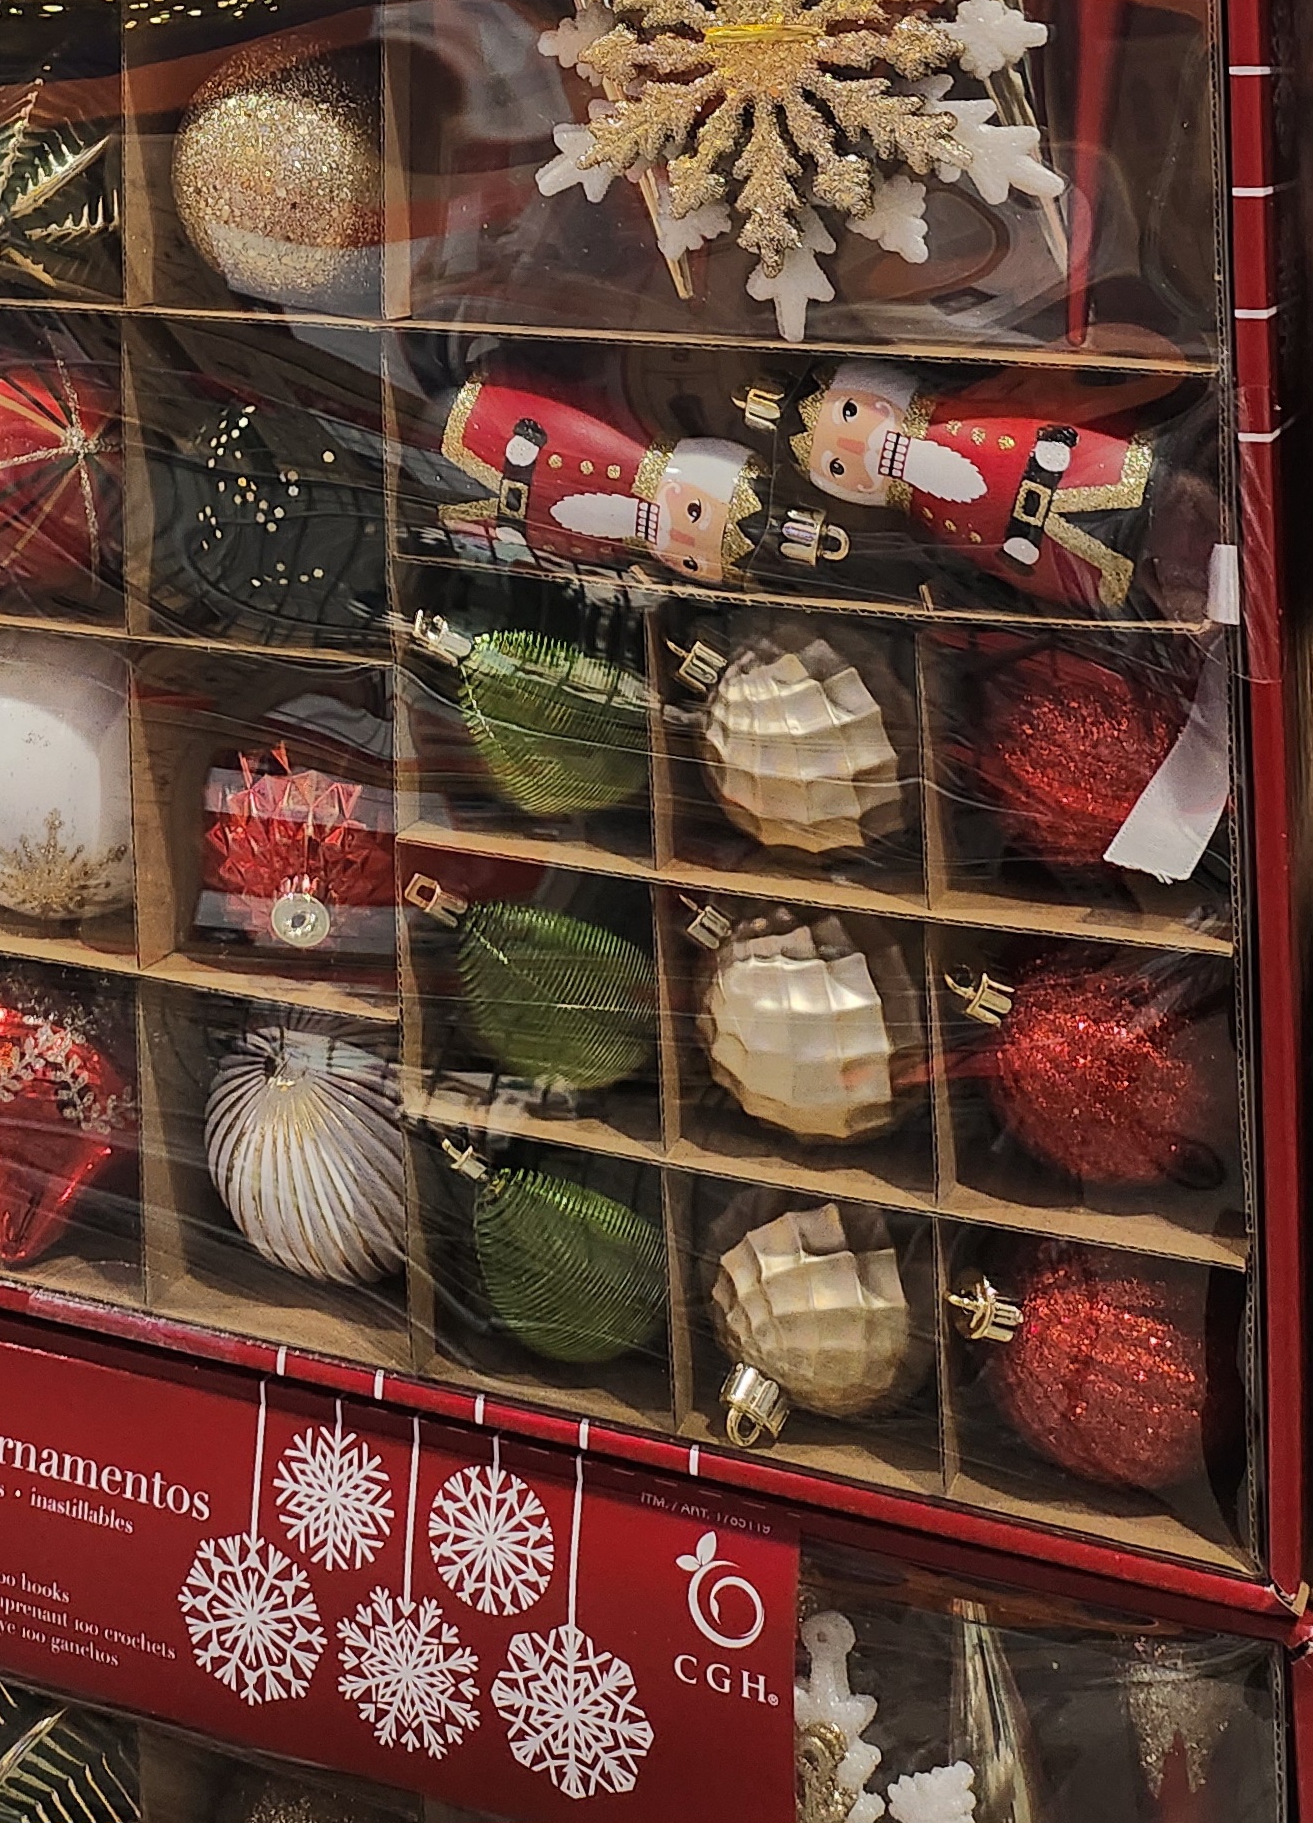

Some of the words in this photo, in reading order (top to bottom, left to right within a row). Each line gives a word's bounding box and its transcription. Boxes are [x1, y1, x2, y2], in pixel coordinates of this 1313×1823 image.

[29, 1486, 135, 1535] inastillables
[21, 1572, 71, 1605] hooks
[21, 1627, 47, 1646] 100
[50, 1633, 120, 1668] ganchos
[73, 1616, 100, 1637] 100
[103, 1621, 177, 1662] crochets
